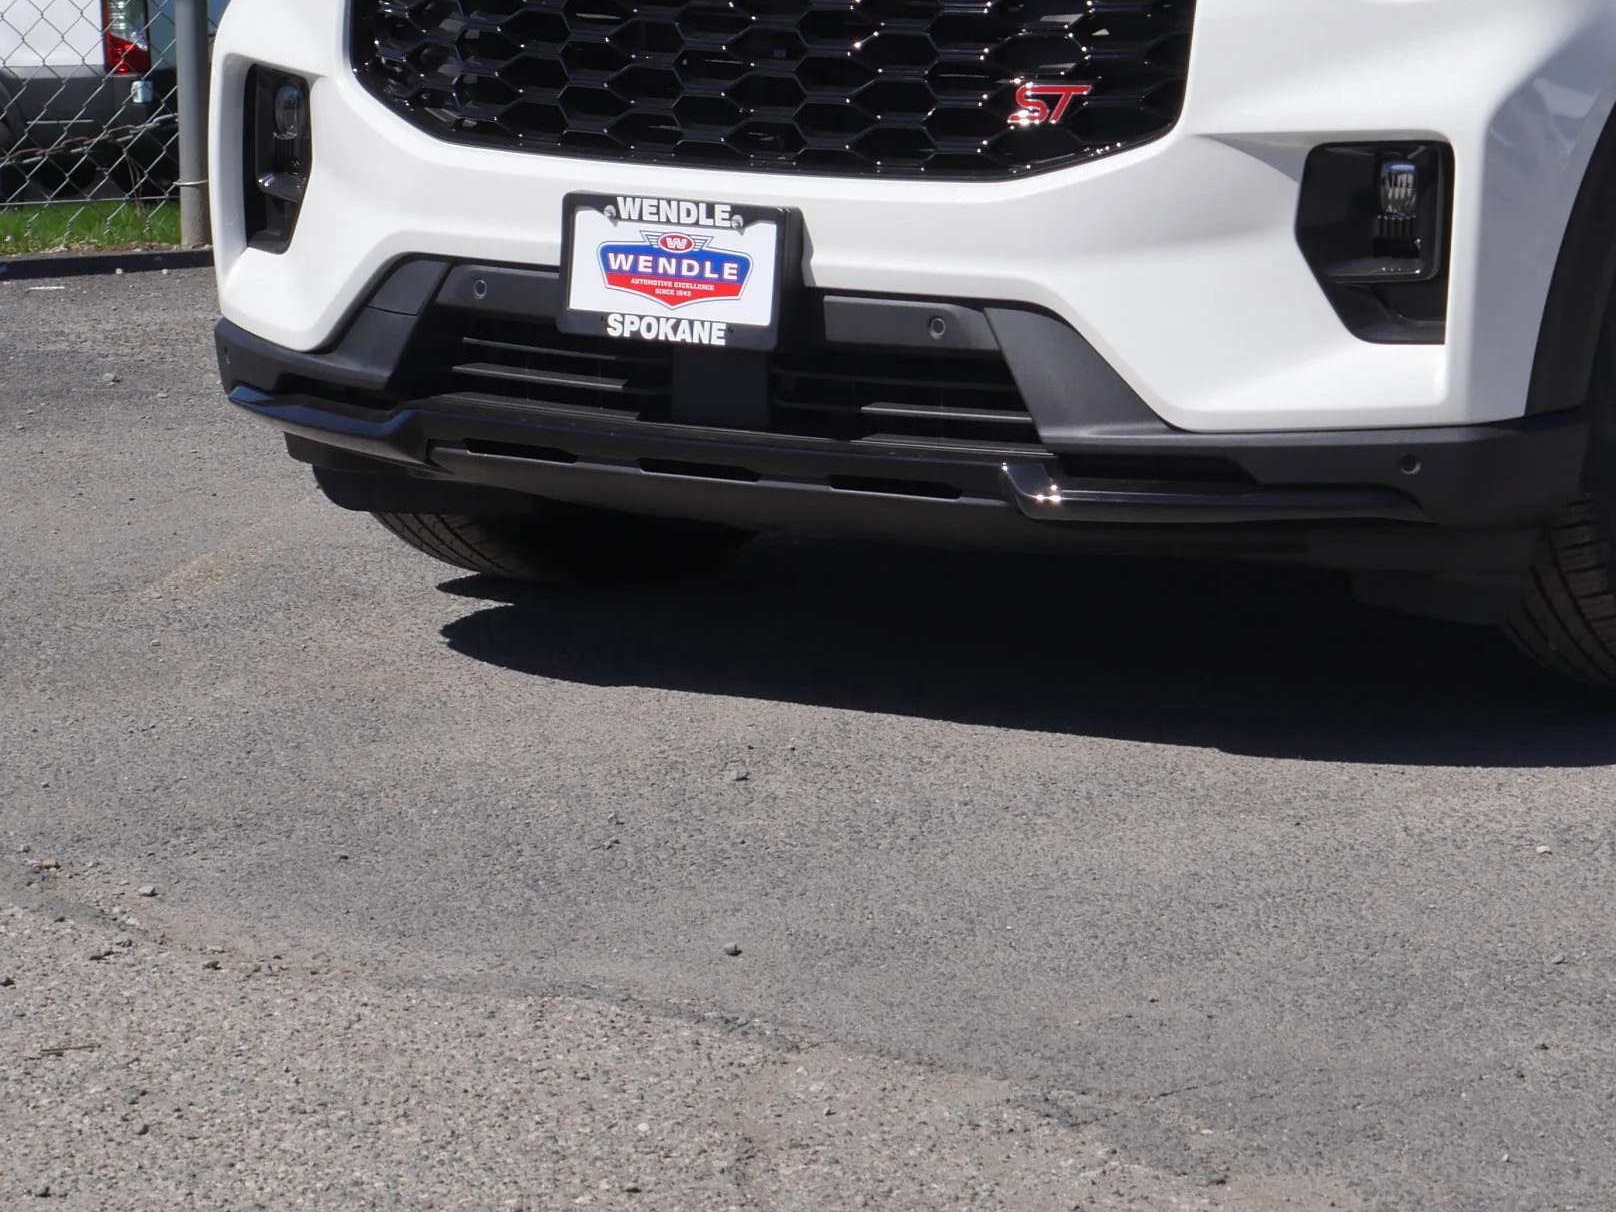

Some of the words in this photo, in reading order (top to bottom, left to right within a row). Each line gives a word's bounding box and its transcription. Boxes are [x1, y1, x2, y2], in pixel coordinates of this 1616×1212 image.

[1007, 83, 1092, 124] ST
[617, 196, 732, 228] WENDLE
[607, 252, 739, 281] WENDLE
[630, 277, 673, 288] AUTOMOTIVE
[673, 281, 715, 291] EXCELLENCE
[655, 287, 675, 296] SINCE
[606, 313, 727, 346] SPOKANE
